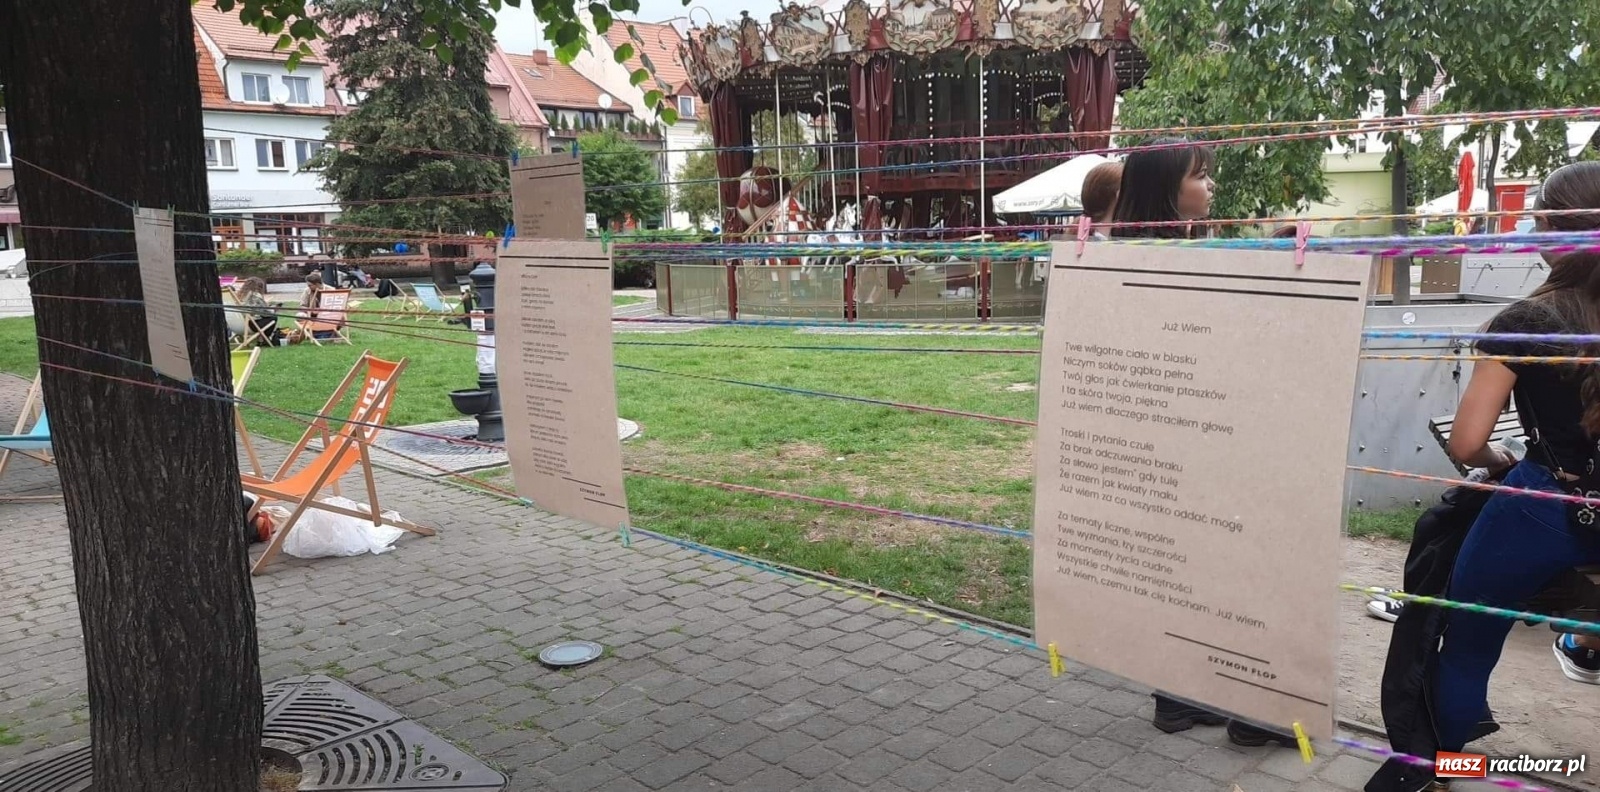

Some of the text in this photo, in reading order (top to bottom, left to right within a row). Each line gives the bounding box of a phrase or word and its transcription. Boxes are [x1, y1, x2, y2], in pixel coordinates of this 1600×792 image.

[1161, 321, 1212, 334] Już Wiem
[1063, 357, 1193, 381] Niczym soków gąbka pełna
[1065, 341, 1197, 365] Twe wilgotne ciało w blasku
[1061, 385, 1168, 409] I ta skóra twoja, piękna
[1062, 370, 1227, 401] Twój głos jak ćwierkanie ptaszków
[1061, 399, 1234, 435] Już wiem dlaczego straciłem głowę
[1060, 427, 1085, 440] Troski
[1092, 432, 1127, 447] pytania
[1129, 439, 1155, 452] czułe
[1059, 441, 1183, 472] Za brak odczuwania braku
[1059, 455, 1071, 465] Za
[1073, 456, 1099, 471] słowo
[1138, 470, 1159, 485] gdy
[1160, 474, 1179, 488] tulę
[1059, 468, 1178, 502] Że razem jak kwiaty maku
[1059, 483, 1243, 533] Już wiem za co wszystko oddać mogę
[1057, 511, 1175, 546] Za tematy liczne, wspólne
[1057, 524, 1075, 536] Twe
[1077, 530, 1121, 549] wyznania,
[1137, 544, 1187, 563] szczerości
[1056, 551, 1193, 594] Wszystkie chwile namiętności
[1057, 537, 1068, 548] Za
[1070, 541, 1114, 560] momenty
[1141, 559, 1173, 575] cudne
[1056, 565, 1071, 576] Już
[1073, 569, 1099, 585] wiem,
[1100, 576, 1131, 593] czemu
[1134, 585, 1149, 597] tak
[1151, 590, 1166, 603] cię
[1215, 608, 1232, 621] Już
[1235, 614, 1268, 631] wiem.
[1207, 655, 1277, 680] SZYMON FLOP
